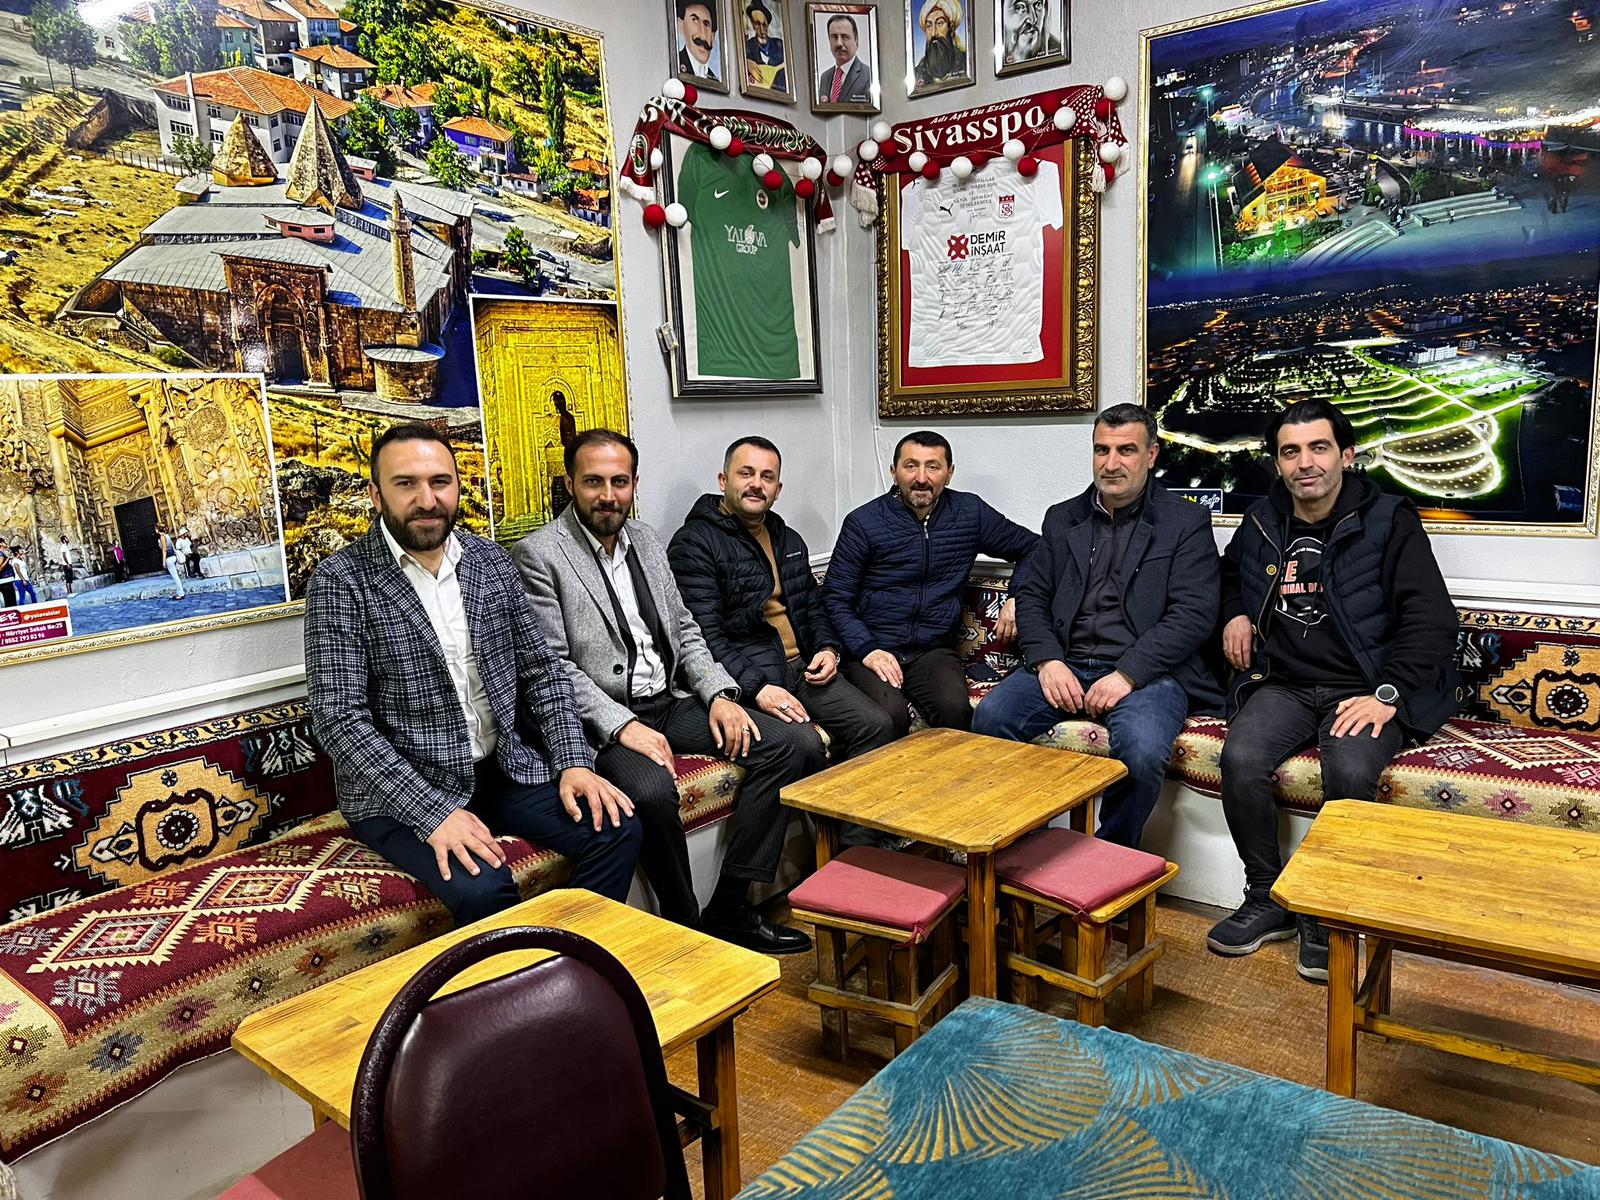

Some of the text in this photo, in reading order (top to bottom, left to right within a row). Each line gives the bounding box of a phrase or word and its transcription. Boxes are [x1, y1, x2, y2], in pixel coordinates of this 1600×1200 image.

[971, 108, 985, 117] Bu
[893, 105, 1046, 154] Sivasspo
[1281, 560, 1298, 582] E
